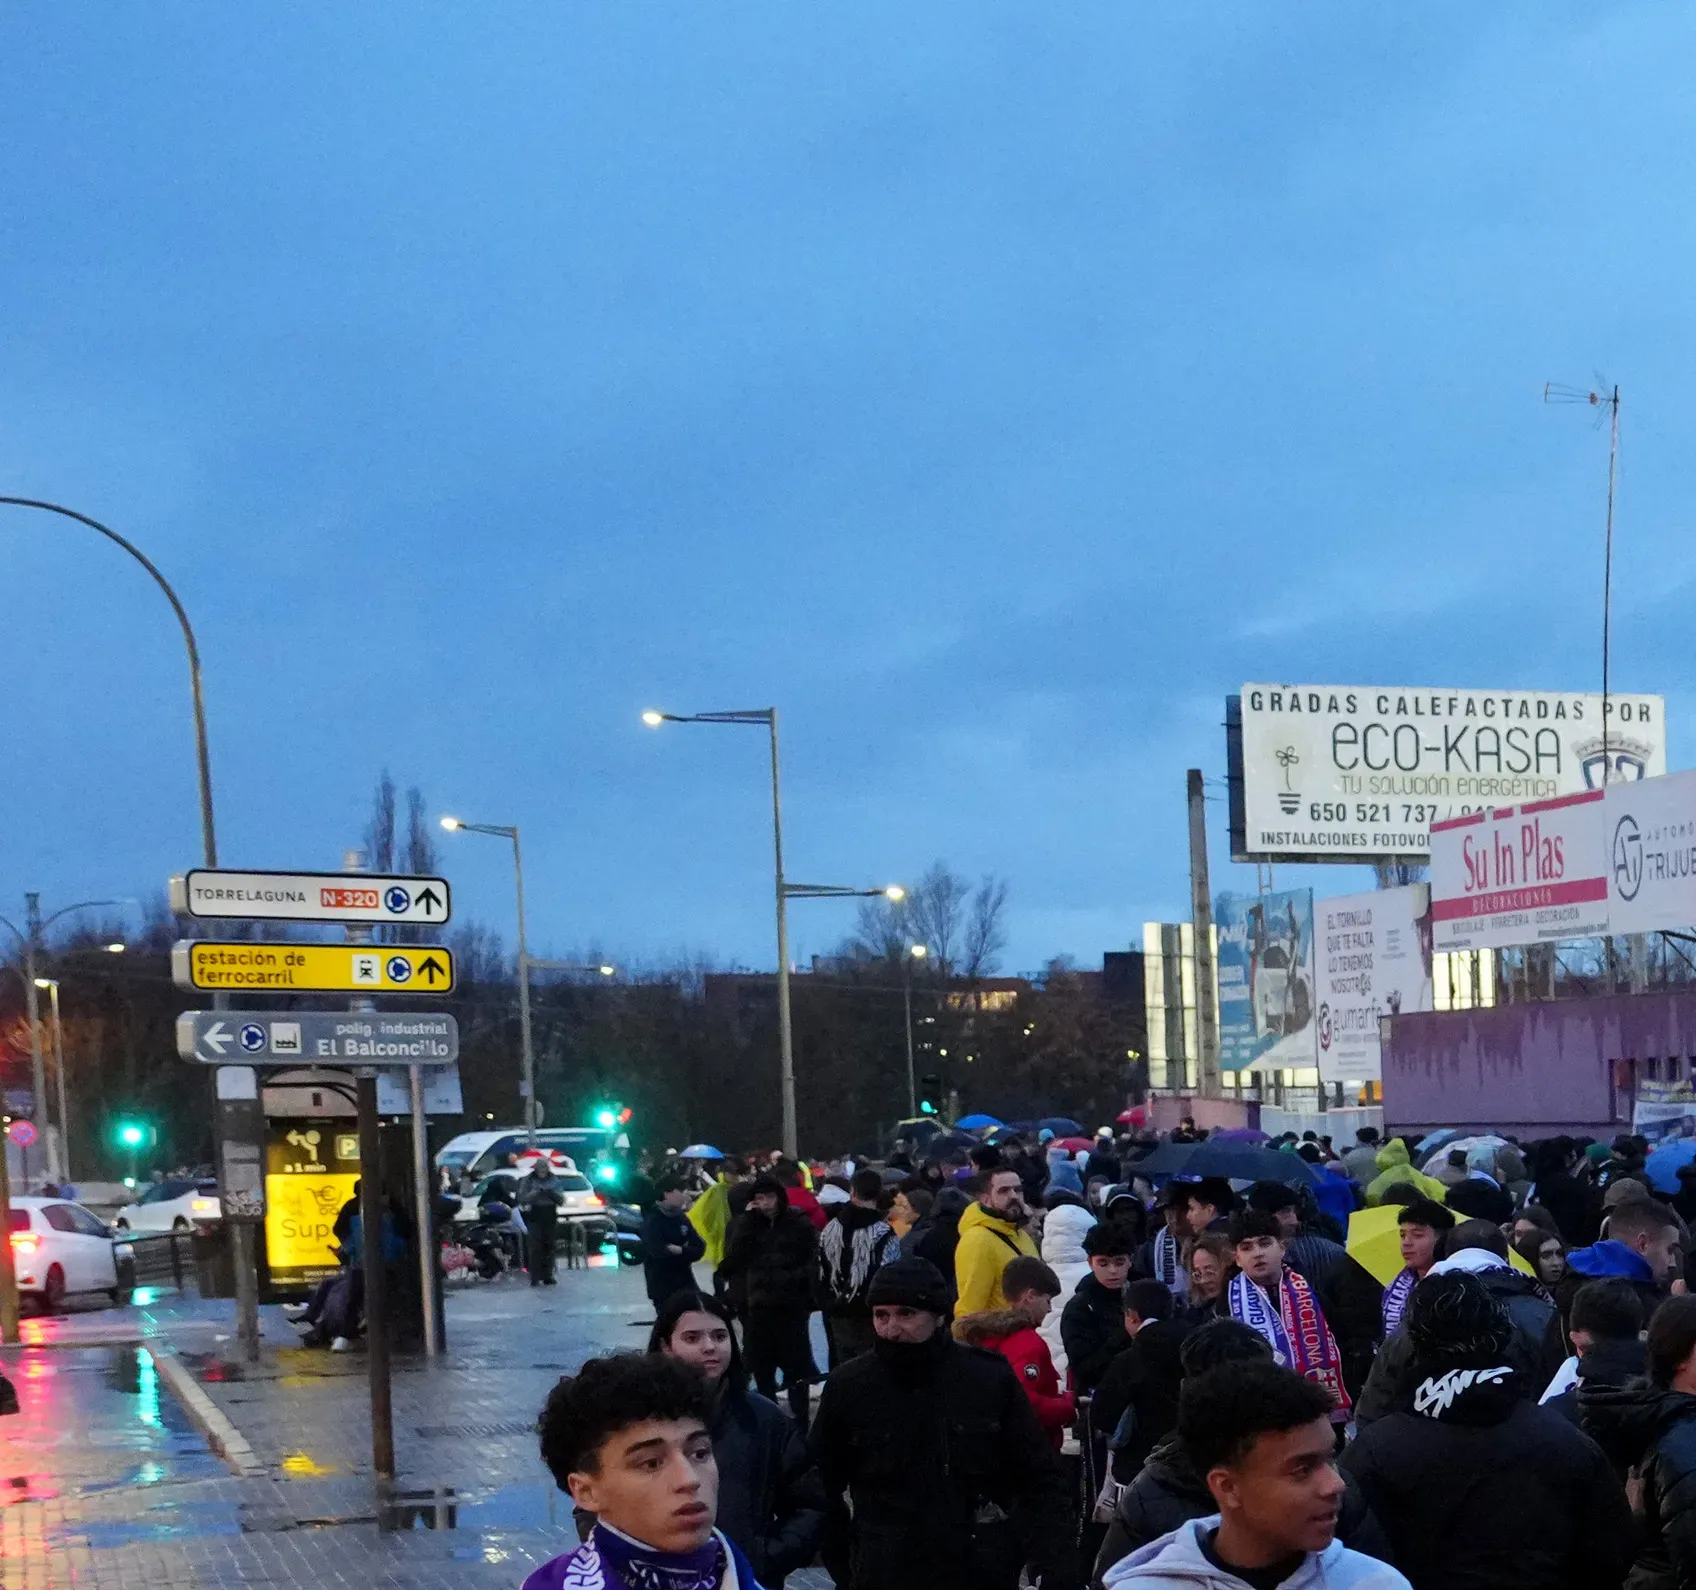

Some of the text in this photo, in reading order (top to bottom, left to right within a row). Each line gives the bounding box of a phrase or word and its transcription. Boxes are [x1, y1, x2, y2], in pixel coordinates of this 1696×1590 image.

[1251, 691, 1652, 723] GRADAS CALEFACTADAS POR
[1310, 803, 1347, 822] 650
[1356, 804, 1391, 822] 521
[1402, 804, 1437, 824] 737
[1261, 832, 1367, 848] INSTALACIONES
[1463, 816, 1565, 893] Su In Plas
[196, 887, 378, 908] TORRELAGUNA N-320
[197, 949, 306, 967] estación de
[197, 968, 295, 985] ferrocarril
[381, 1022, 447, 1036] industrial
[318, 1040, 340, 1056] El
